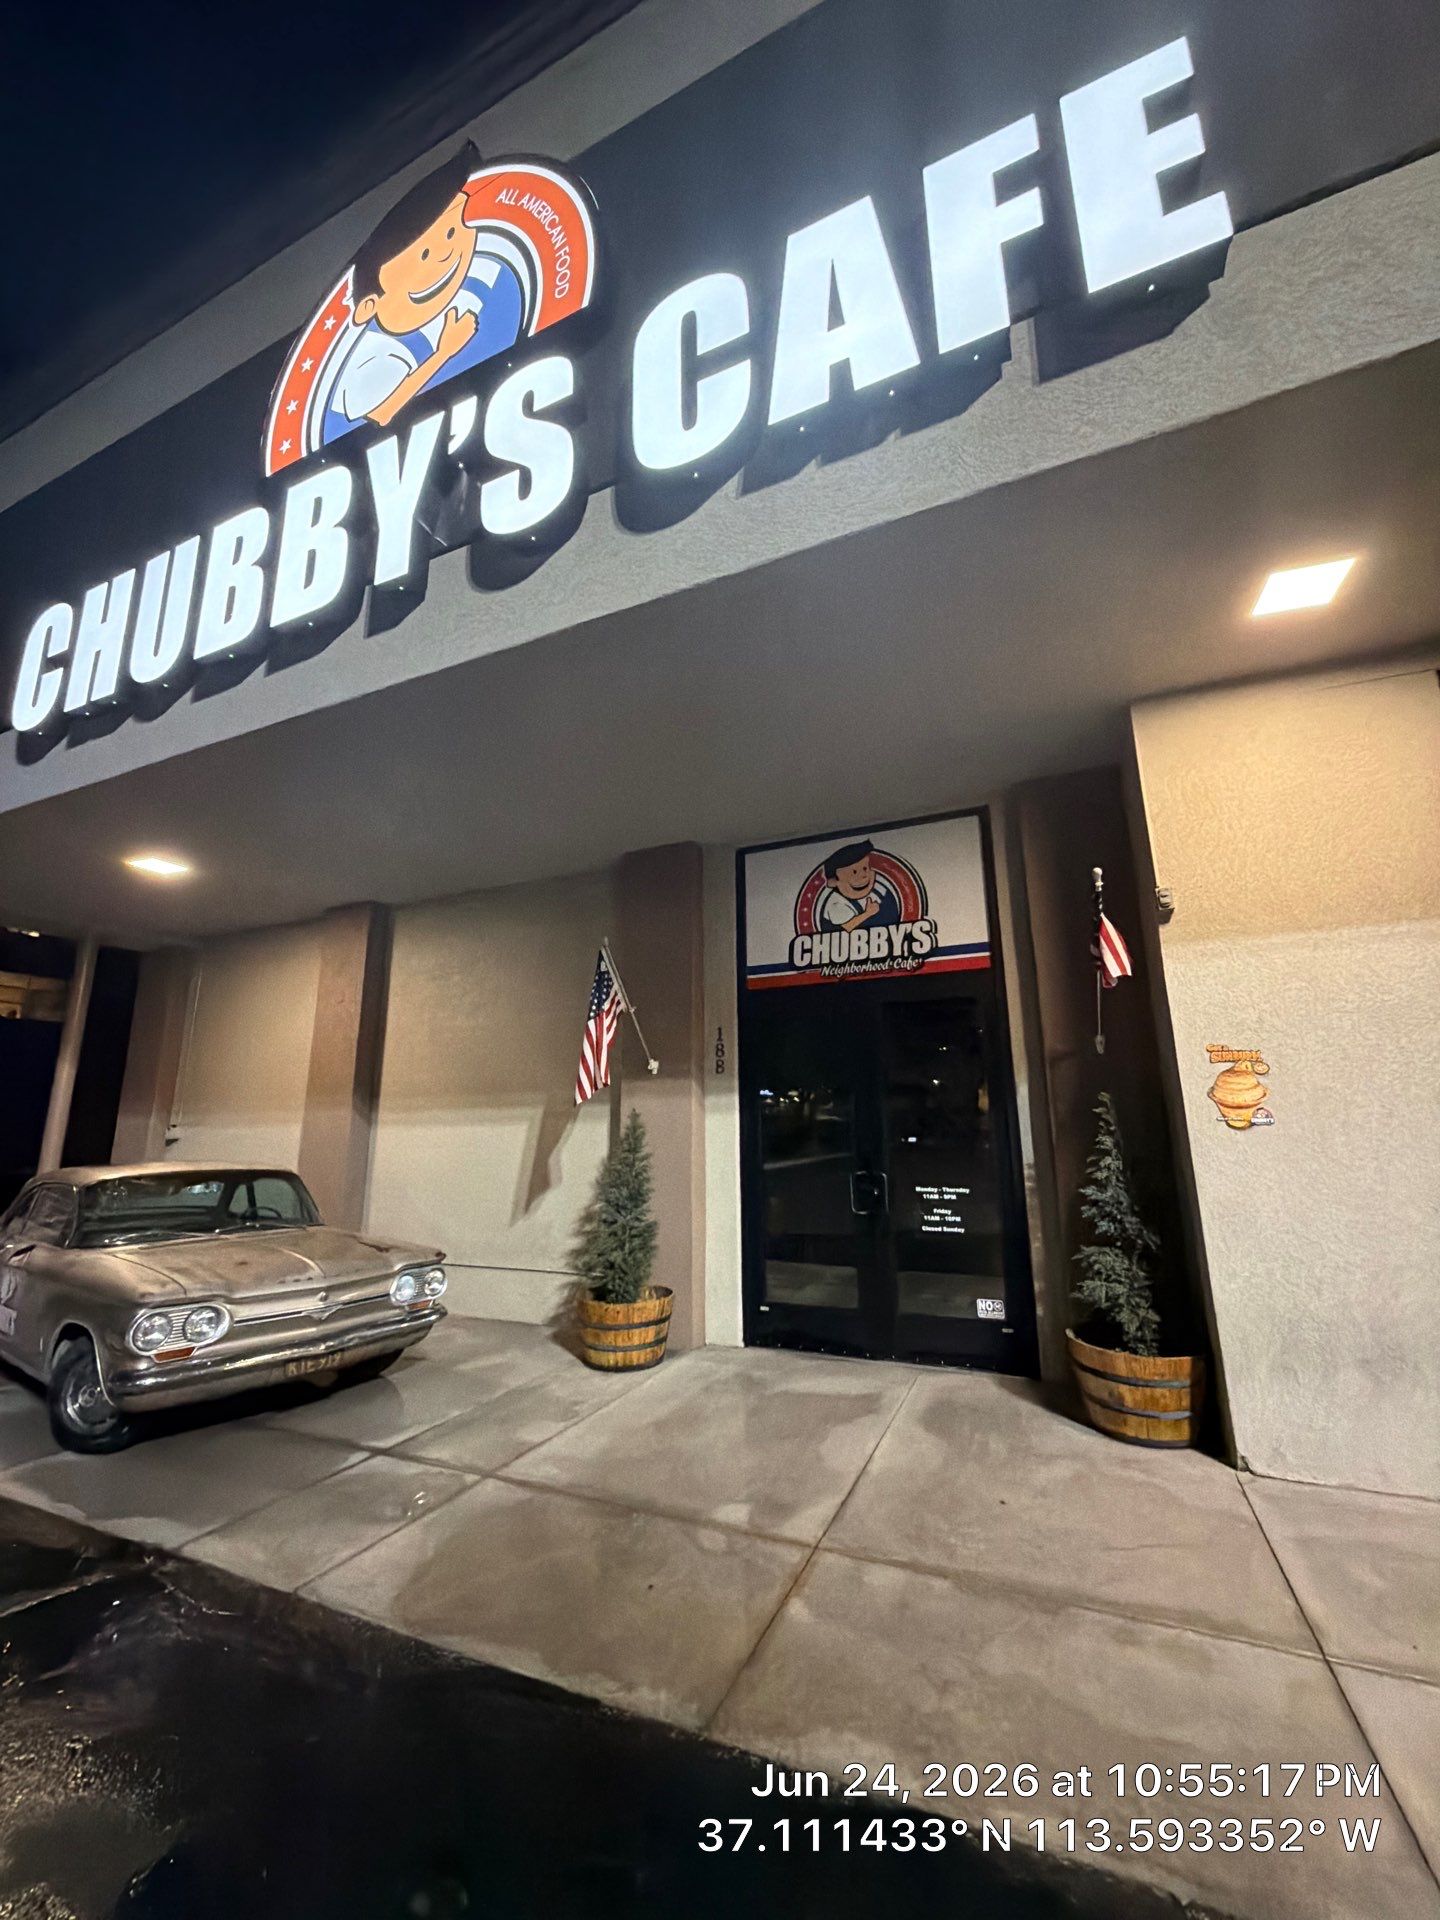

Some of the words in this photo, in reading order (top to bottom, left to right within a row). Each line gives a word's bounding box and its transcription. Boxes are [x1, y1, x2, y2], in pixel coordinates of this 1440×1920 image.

[495, 188, 519, 206] ALL
[517, 192, 567, 250] AMERICAN
[554, 245, 571, 299] FOOD
[12, 356, 574, 733] CHUBBY'S
[632, 36, 1235, 470] CAFE
[793, 919, 932, 967] CHUBBY'S
[820, 959, 890, 978] Neighborhood
[979, 1300, 993, 1311] NO
